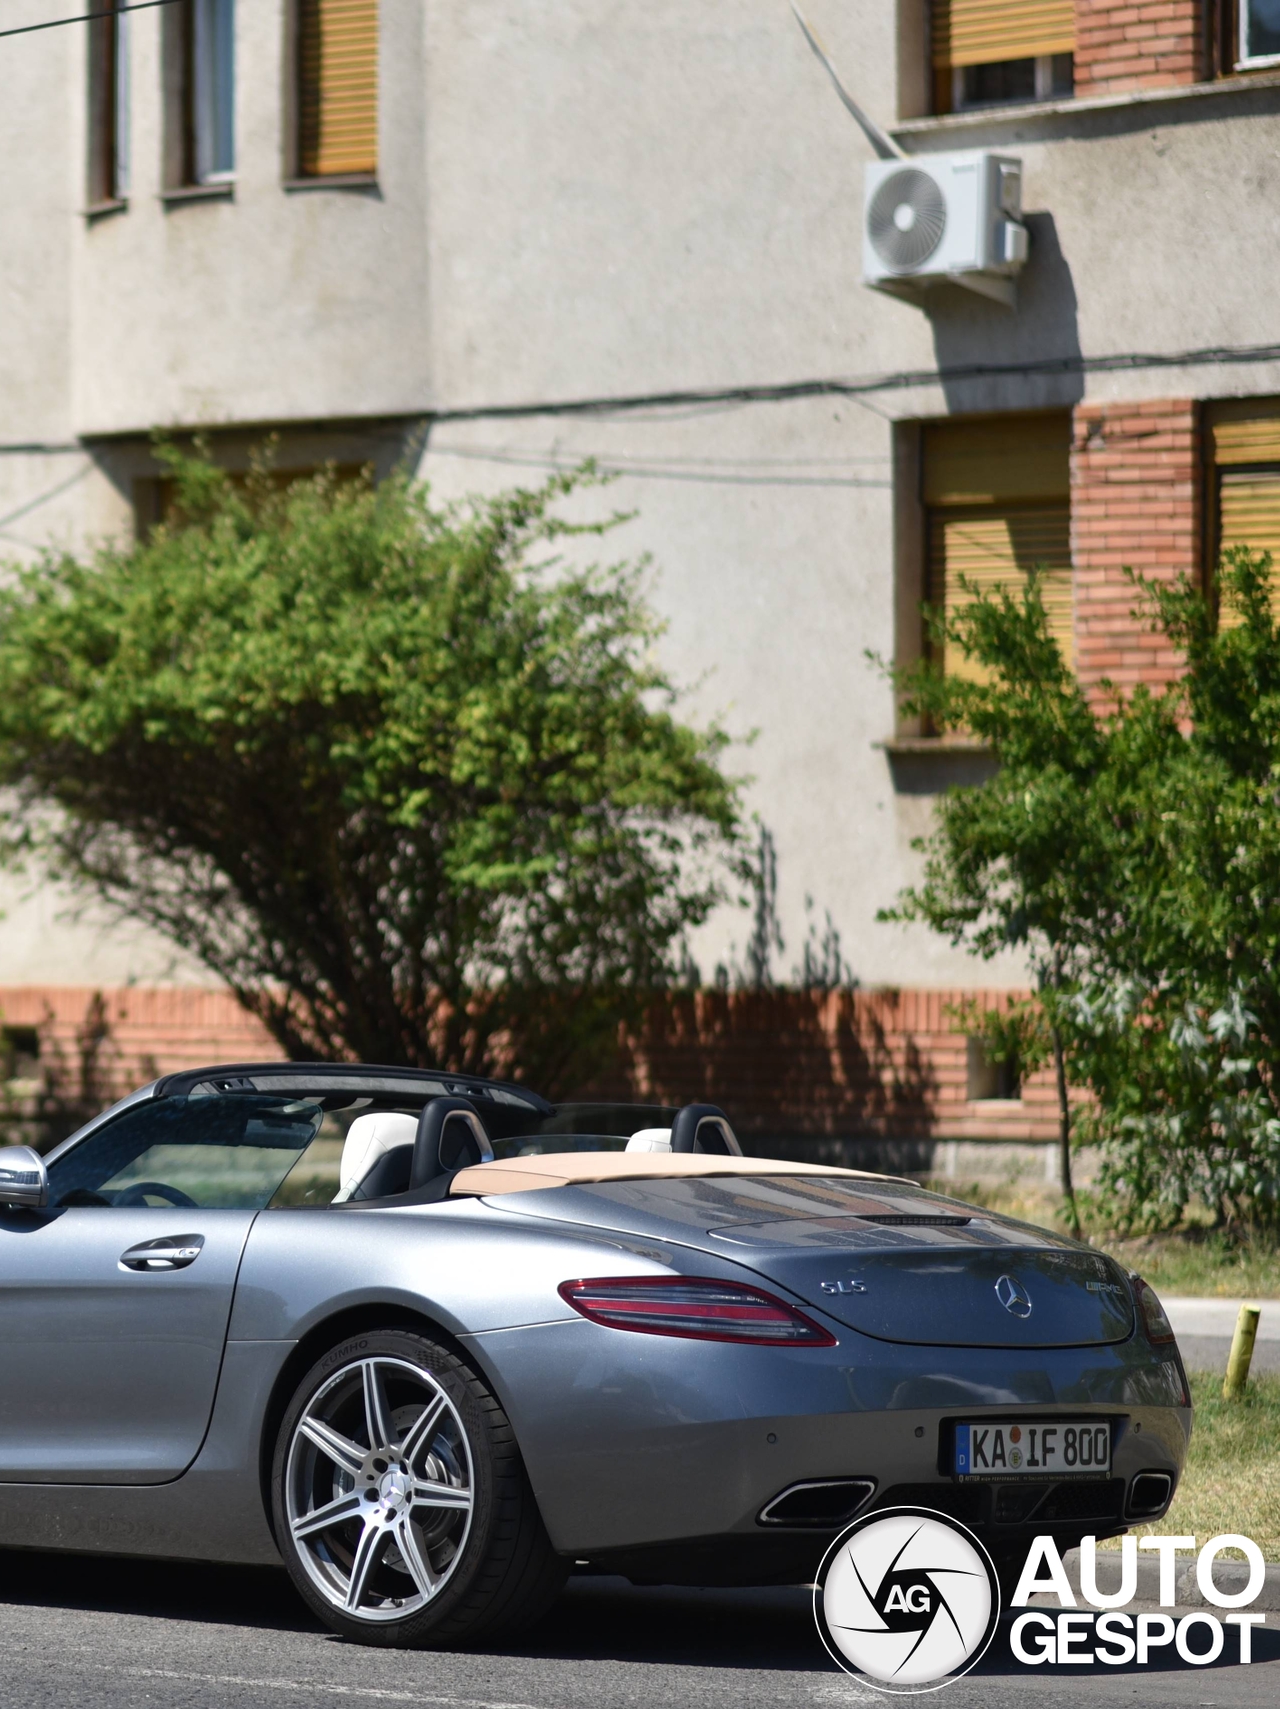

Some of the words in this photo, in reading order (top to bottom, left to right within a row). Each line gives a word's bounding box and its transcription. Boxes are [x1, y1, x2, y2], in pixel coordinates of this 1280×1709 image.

[821, 1280, 867, 1294] SLS
[320, 1340, 368, 1370] KUMHO
[973, 1429, 1007, 1468] KA
[1026, 1428, 1058, 1467] IF
[1064, 1427, 1108, 1467] 800
[959, 1454, 966, 1466] D
